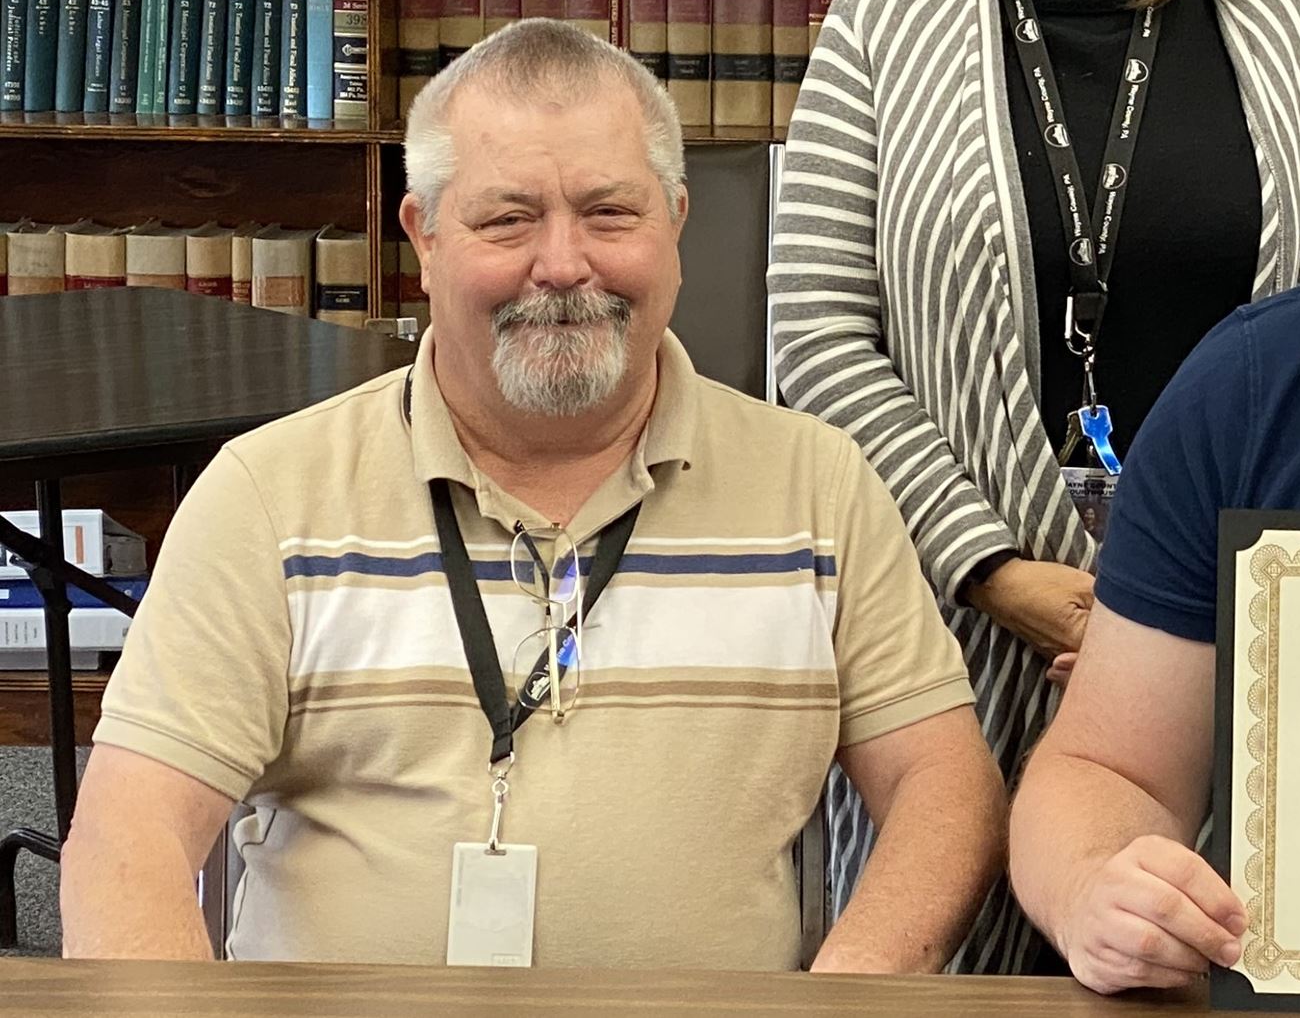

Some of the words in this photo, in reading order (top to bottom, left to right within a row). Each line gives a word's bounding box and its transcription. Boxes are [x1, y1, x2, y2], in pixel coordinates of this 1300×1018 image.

[346, 14, 367, 25] 398
[1128, 84, 1139, 105] Wayne
[1120, 129, 1129, 139] PA
[1106, 191, 1116, 215] Wayne
[1098, 243, 1107, 254] PA
